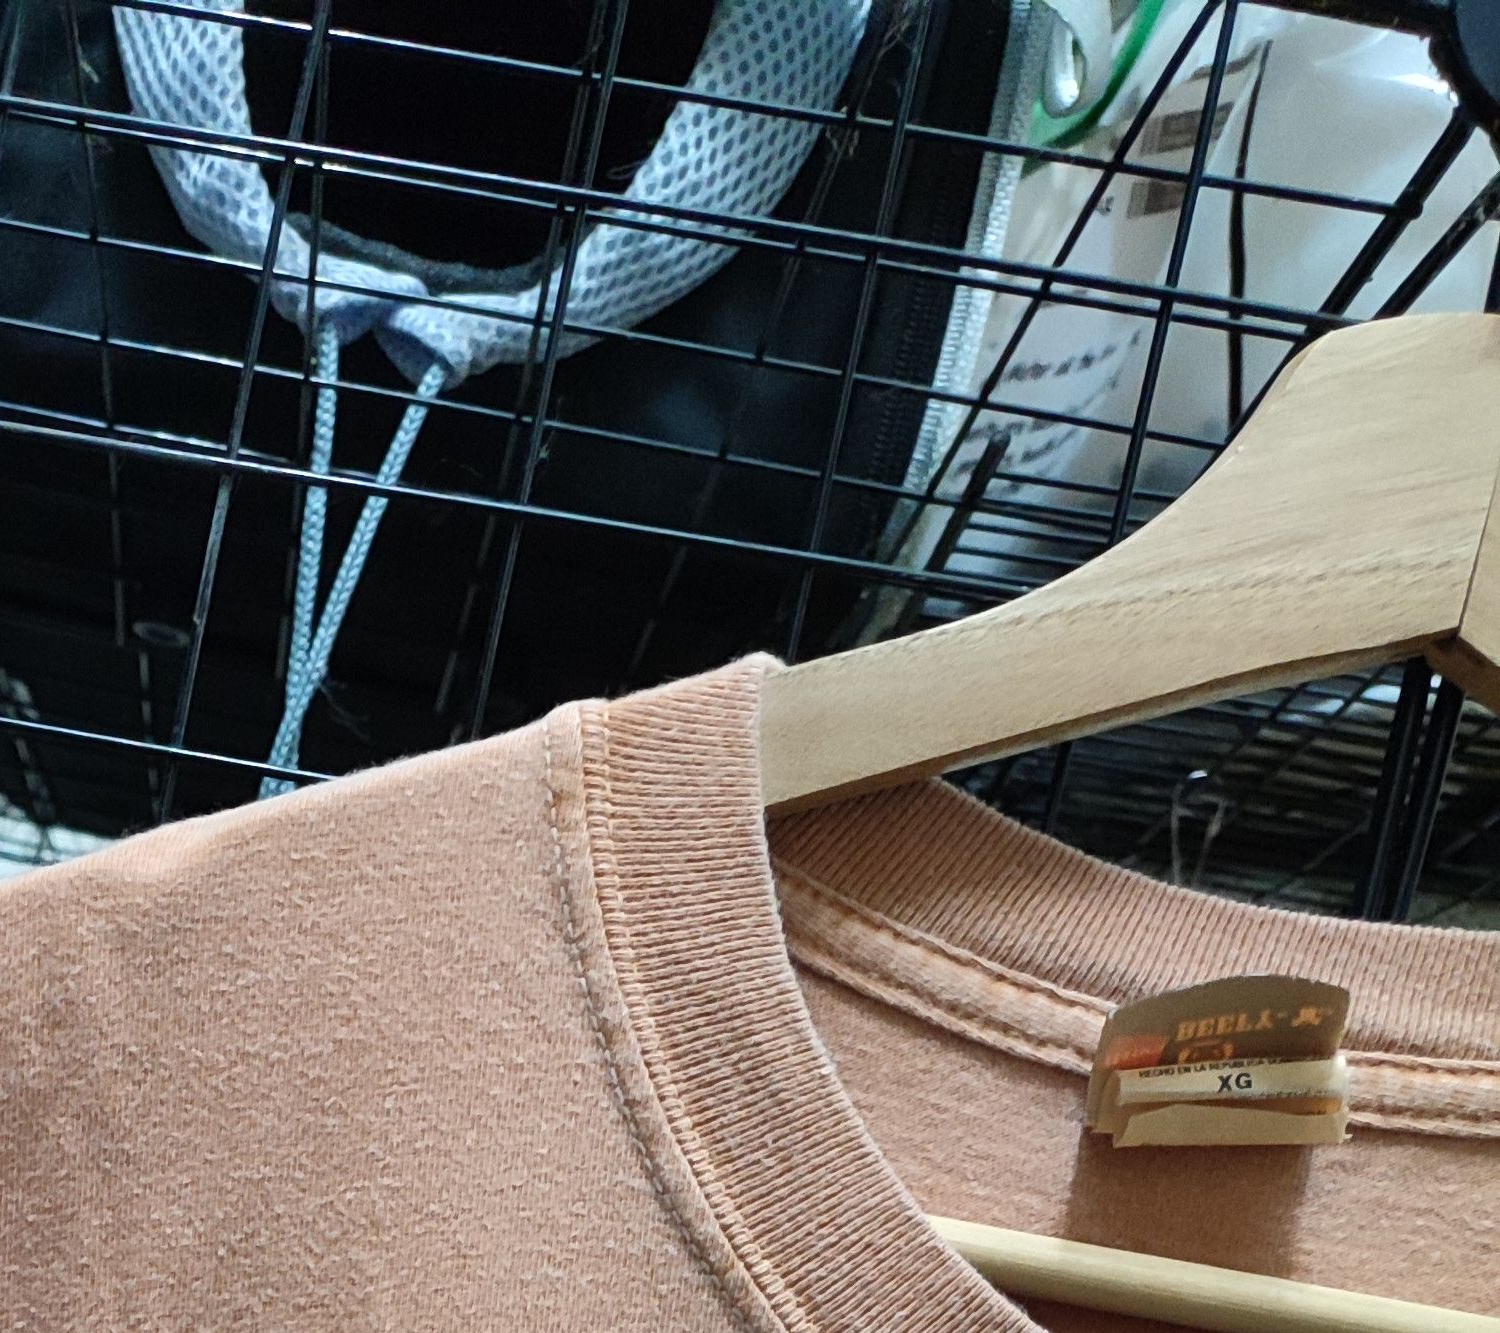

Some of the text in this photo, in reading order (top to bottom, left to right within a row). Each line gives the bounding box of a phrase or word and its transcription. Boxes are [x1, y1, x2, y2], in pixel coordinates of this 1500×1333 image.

[1177, 1065, 1192, 1076] EN
[1194, 1063, 1208, 1073] LA
[1217, 1072, 1253, 1094] XG
